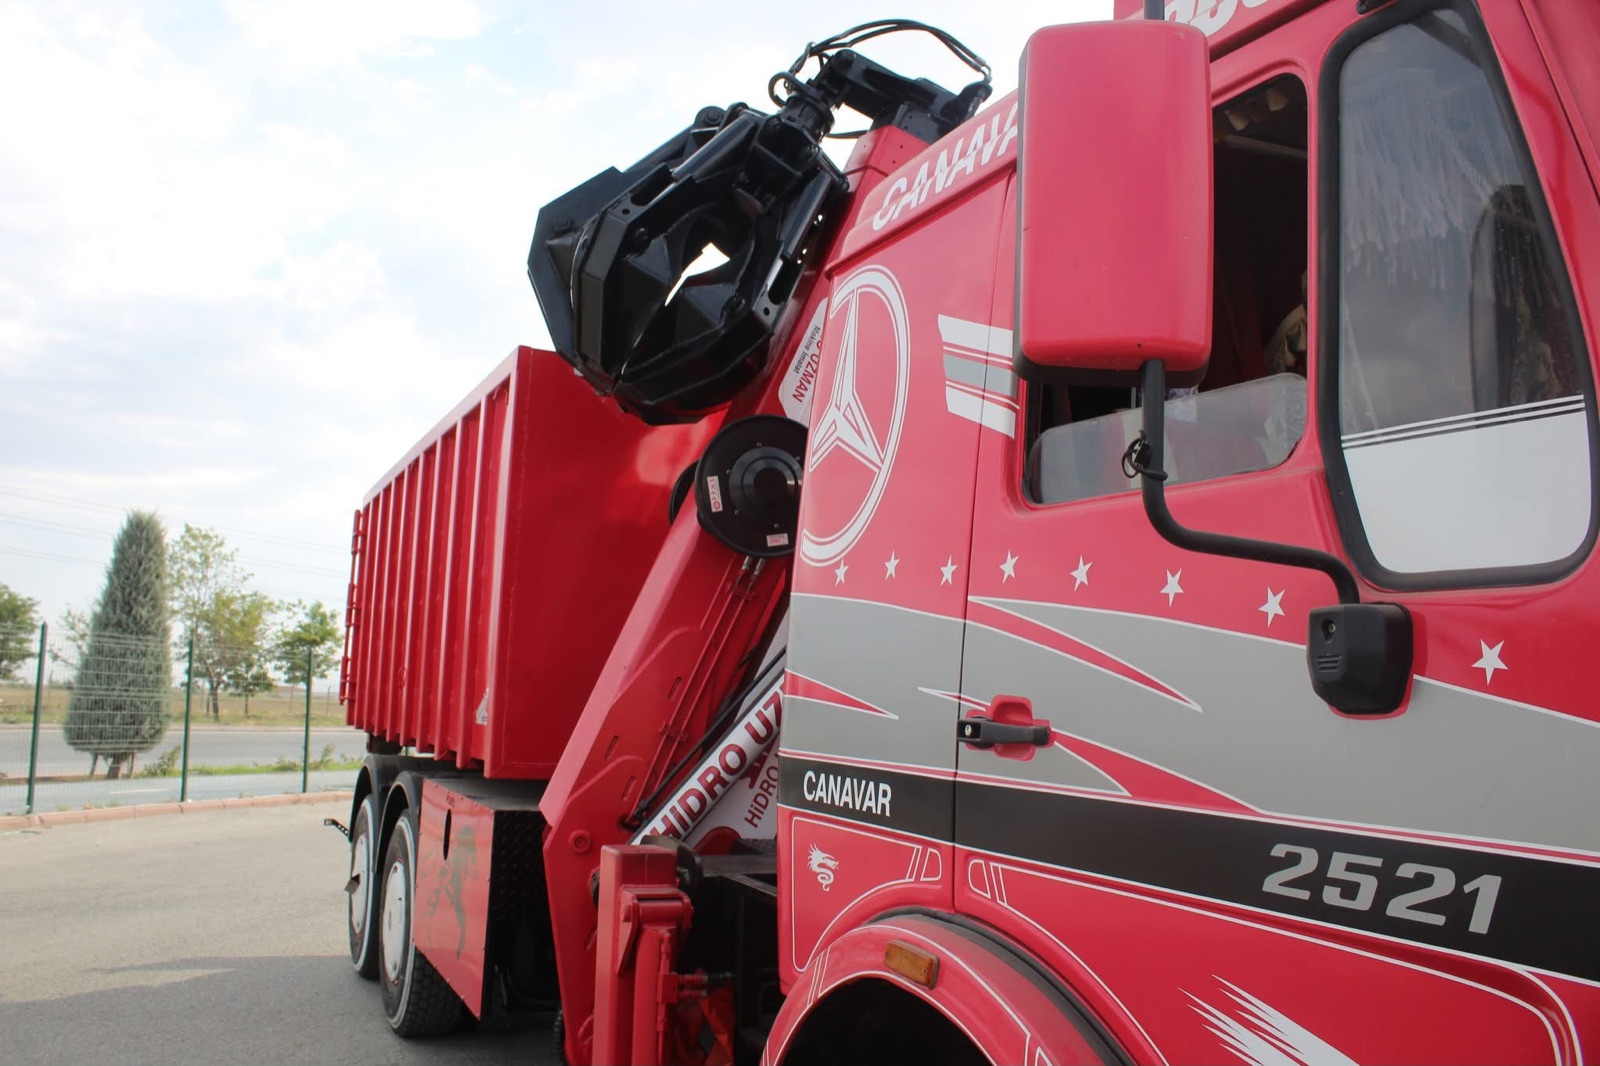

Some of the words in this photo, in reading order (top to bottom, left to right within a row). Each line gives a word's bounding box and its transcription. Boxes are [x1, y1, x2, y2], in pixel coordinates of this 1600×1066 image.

[804, 325, 820, 351] Makine
[792, 353, 819, 403] UZMAN
[744, 683, 784, 745] UZ
[803, 770, 892, 817] CANAVAR
[1262, 843, 1502, 934] 2521
